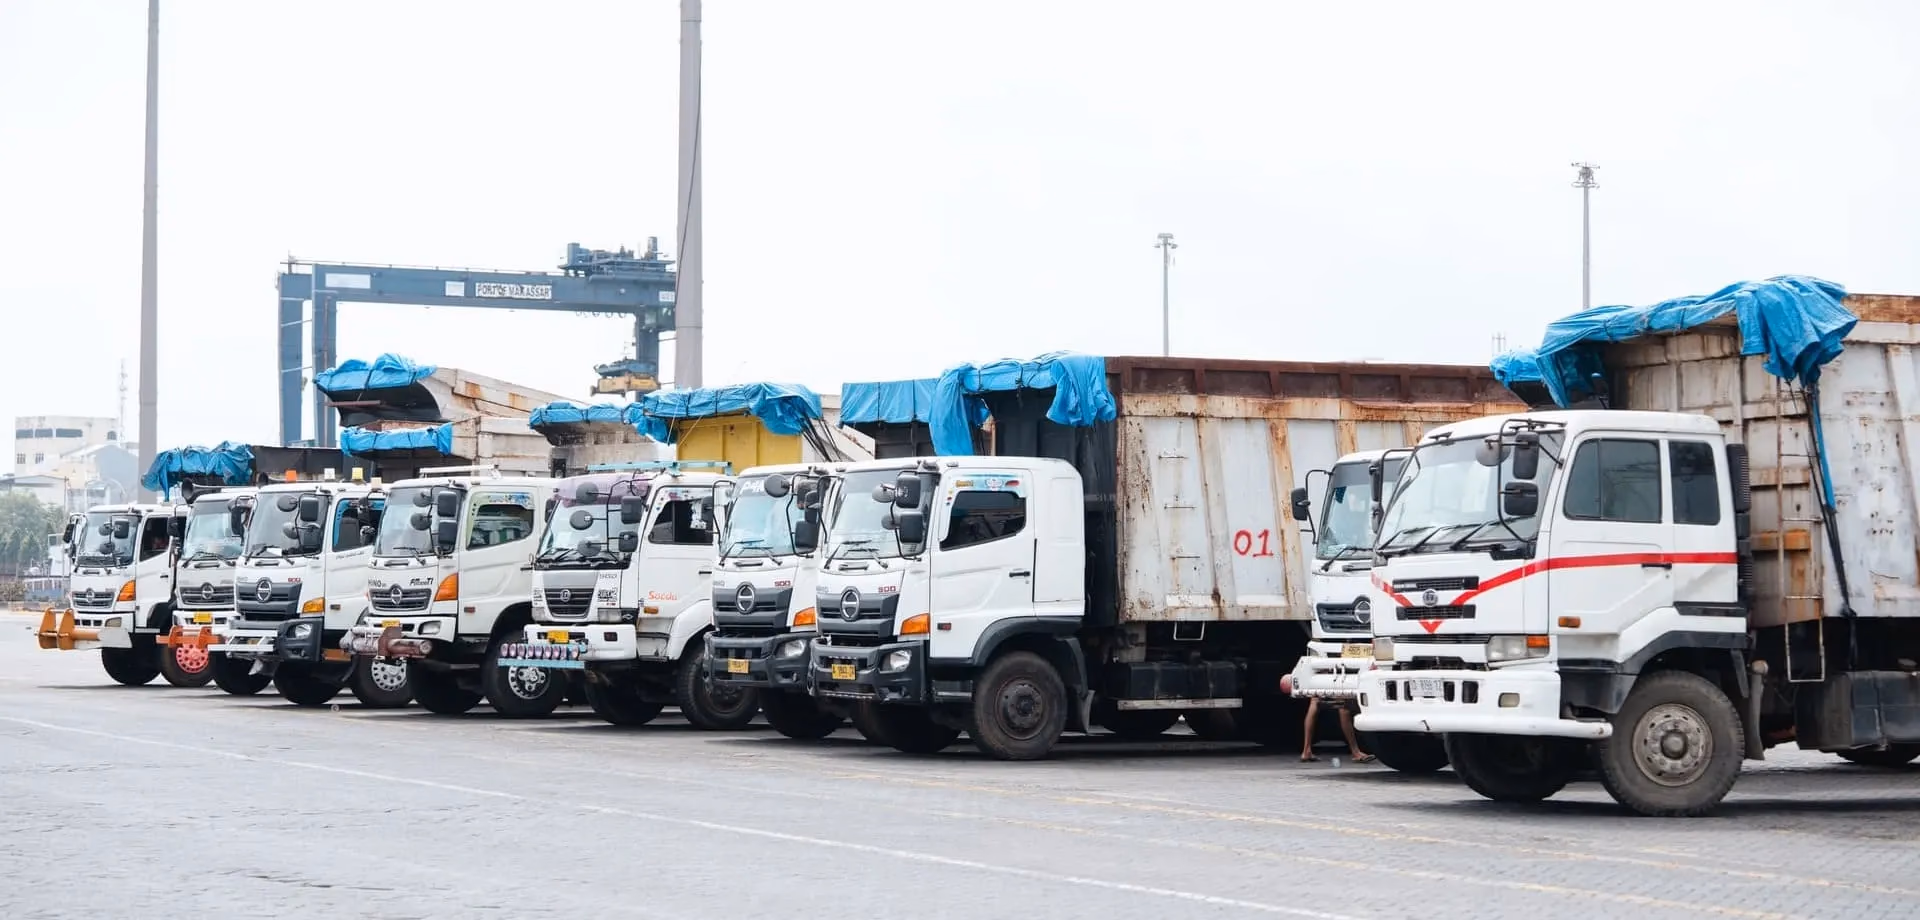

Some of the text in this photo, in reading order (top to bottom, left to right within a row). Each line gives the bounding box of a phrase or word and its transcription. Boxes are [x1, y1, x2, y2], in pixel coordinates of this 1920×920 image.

[477, 284, 496, 296] PORT
[509, 286, 550, 298] MAKASSAR
[1234, 529, 1274, 557] 01
[878, 585, 896, 593] 500
